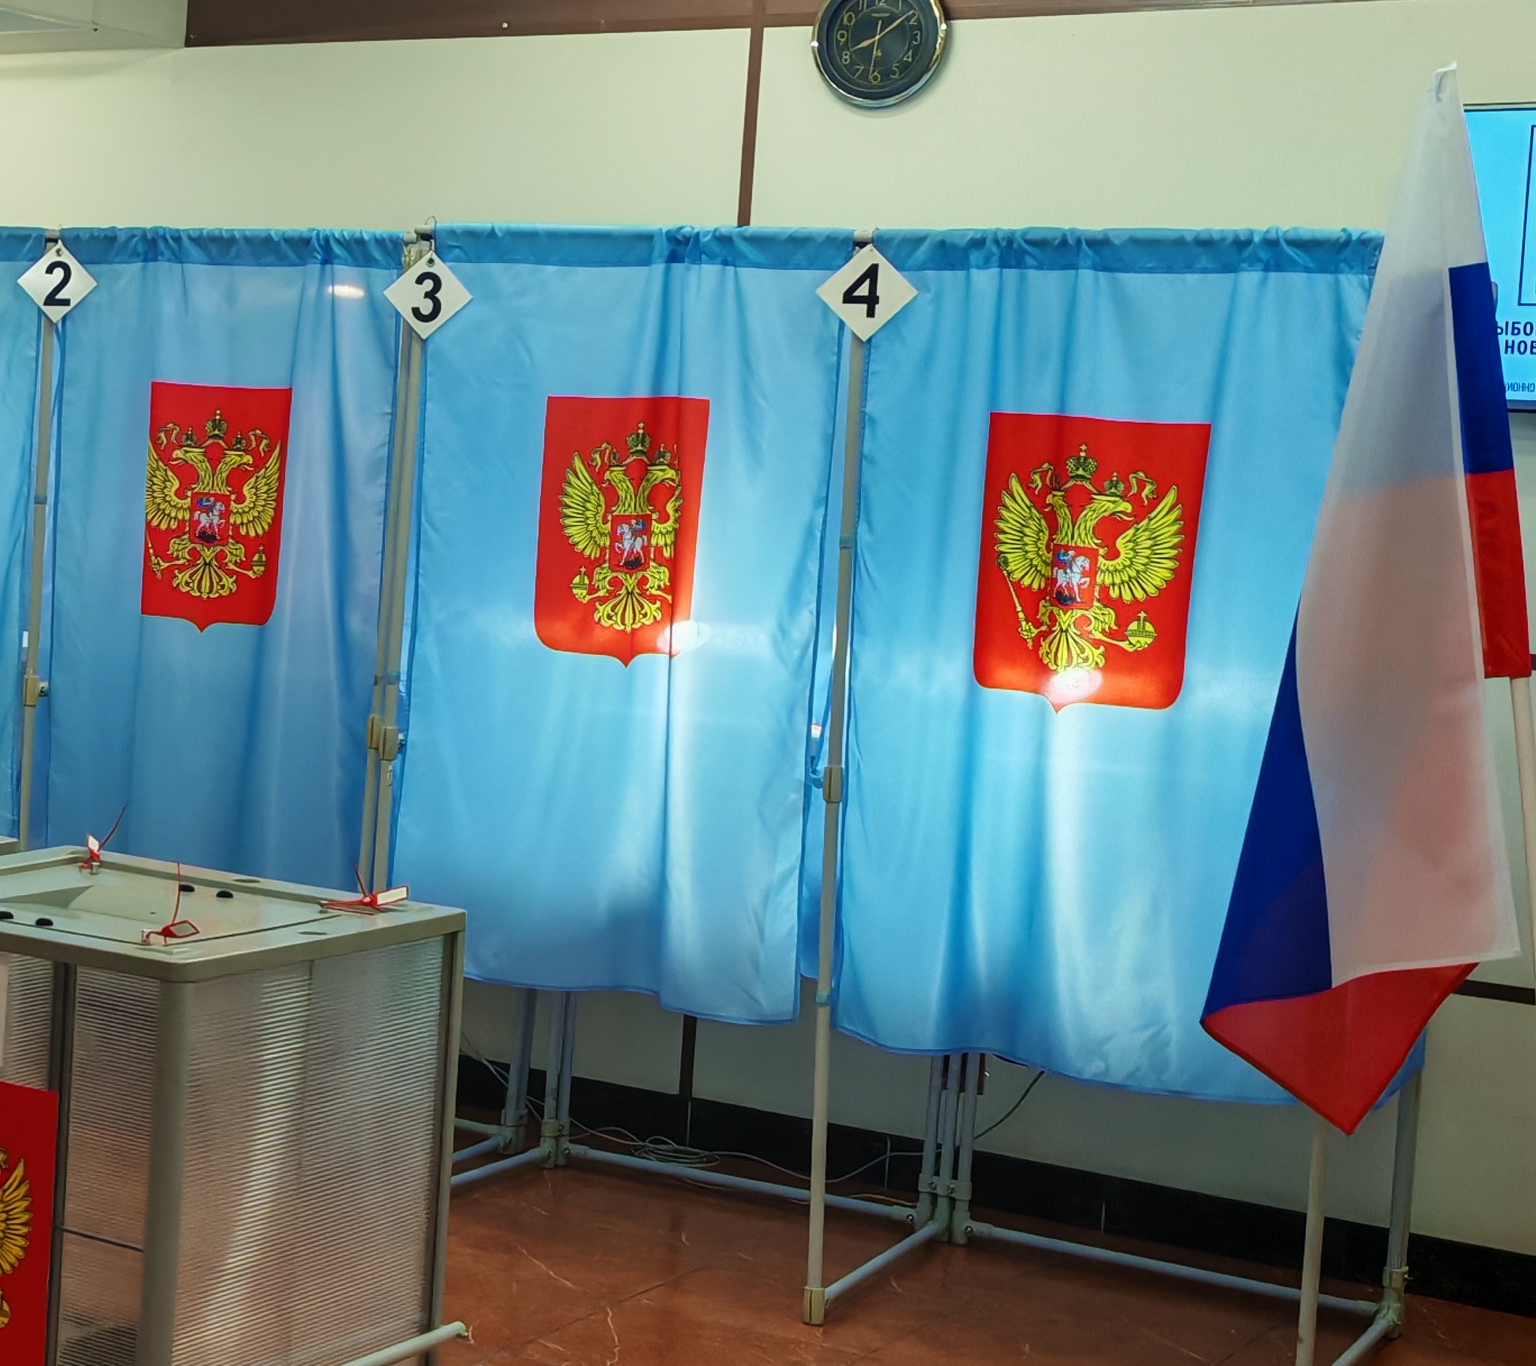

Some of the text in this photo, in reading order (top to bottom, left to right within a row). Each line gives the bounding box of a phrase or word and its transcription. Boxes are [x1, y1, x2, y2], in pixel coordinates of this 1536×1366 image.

[909, 9, 918, 25] 2
[837, 30, 847, 45] 9
[912, 30, 921, 45] 3
[841, 51, 850, 64] 8
[903, 49, 913, 63] 4
[854, 65, 864, 79] 7
[870, 69, 881, 84] 6
[890, 63, 900, 78] 5
[42, 260, 73, 307] 2
[841, 263, 880, 319] 4
[411, 271, 443, 323] 3
[1497, 321, 1536, 336] ЫБО
